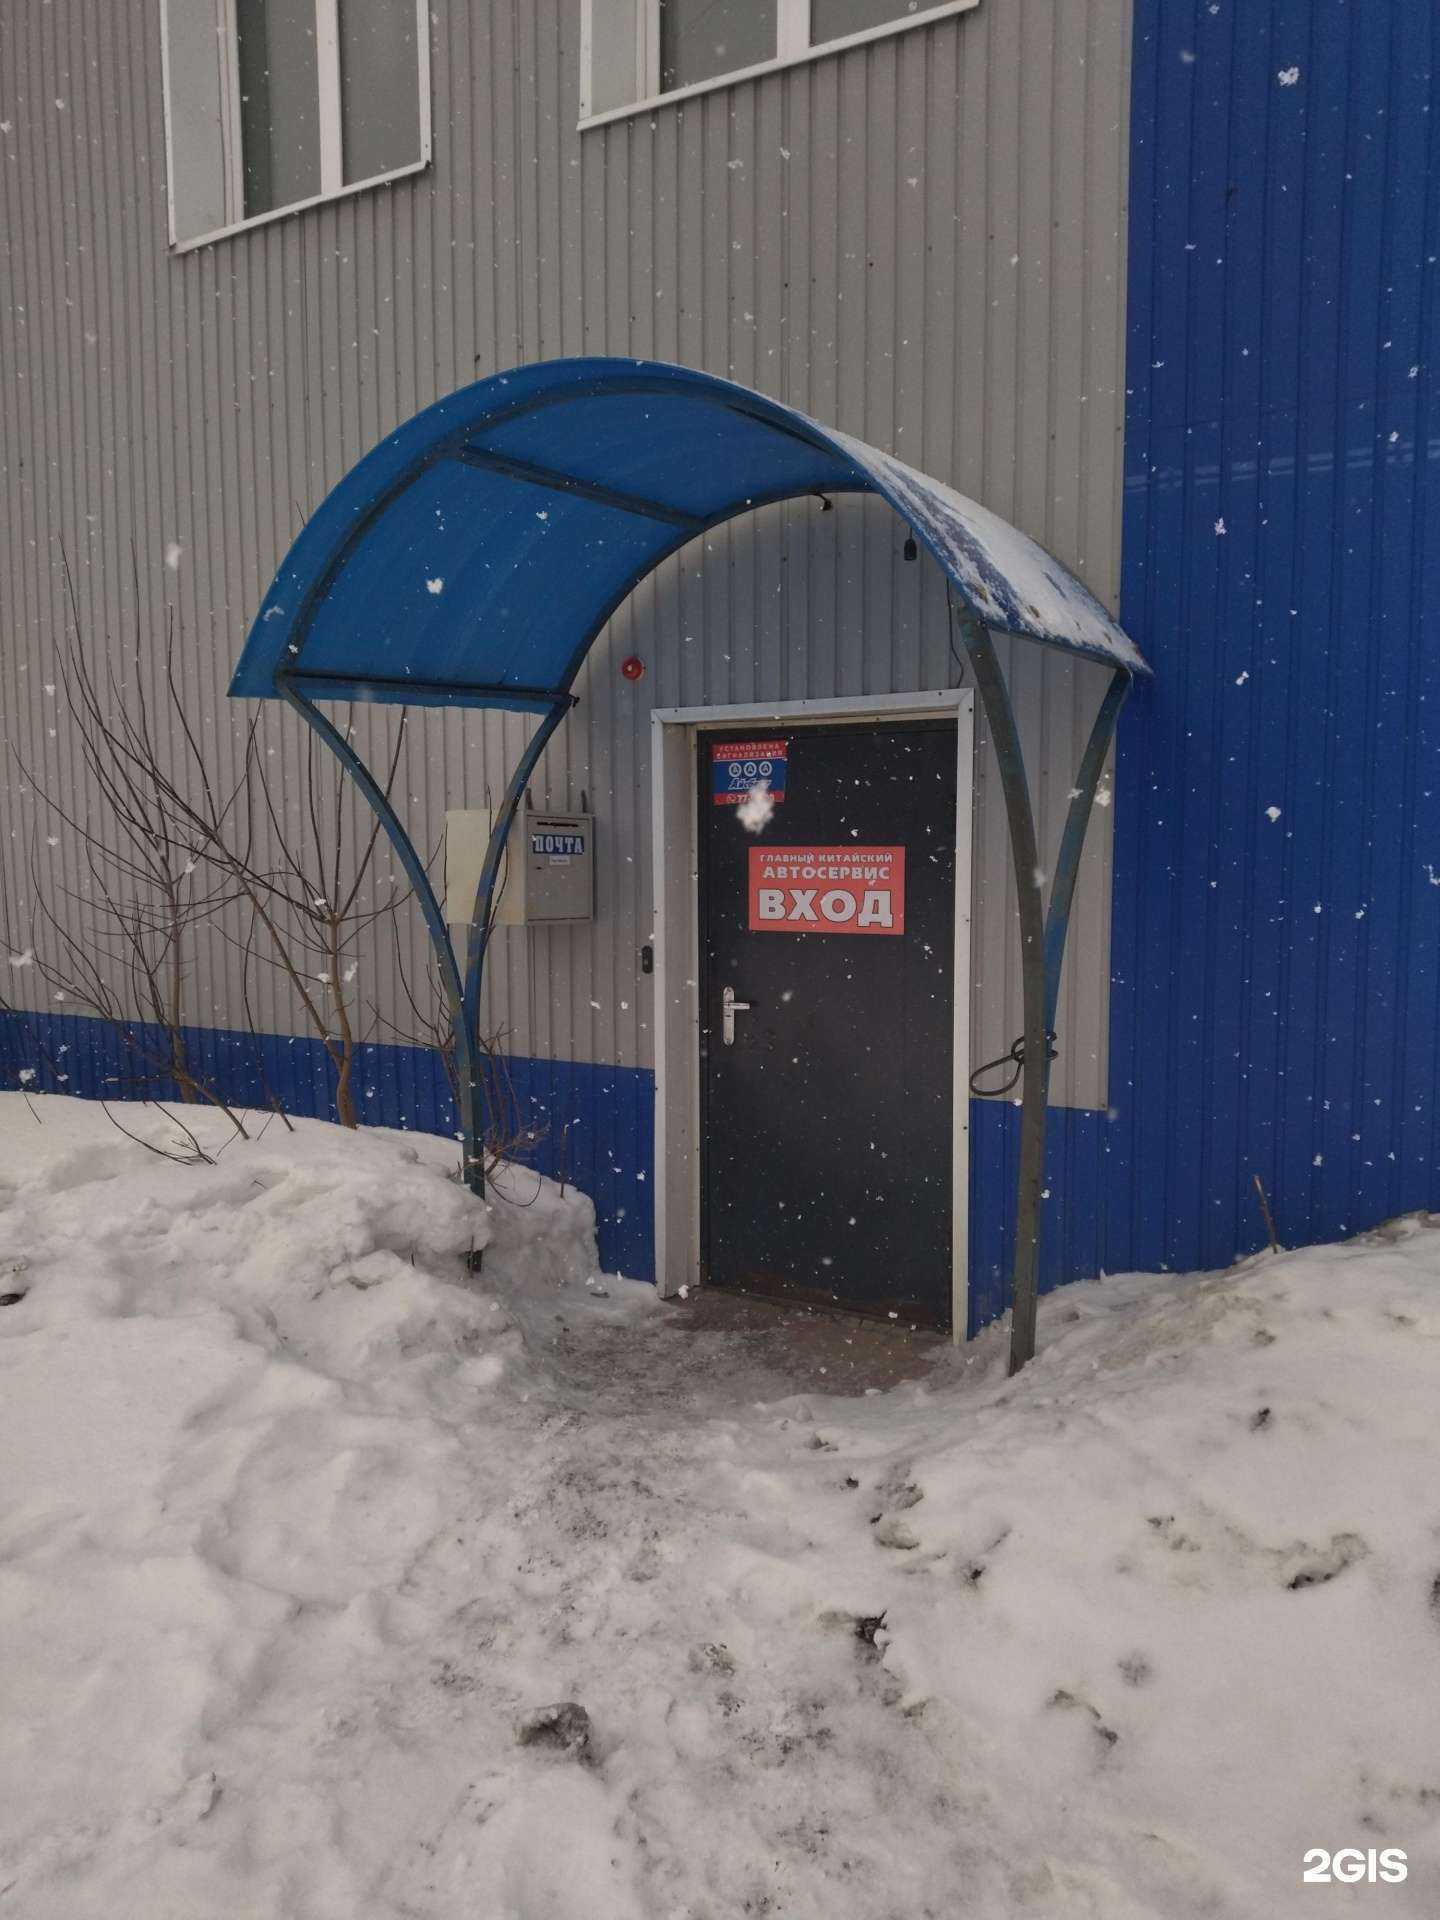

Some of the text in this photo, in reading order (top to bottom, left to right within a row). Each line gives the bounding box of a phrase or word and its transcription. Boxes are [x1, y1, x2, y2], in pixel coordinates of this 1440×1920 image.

[716, 750, 783, 760] СИГНАЛИЗАИЯ
[535, 835, 583, 853] ПОЧТА
[760, 852, 893, 863] ГЛАВНЫЙ КИТАЙСКИЙ
[763, 866, 890, 879] АВТОСЕРВИС
[758, 888, 894, 928] ВХОД
